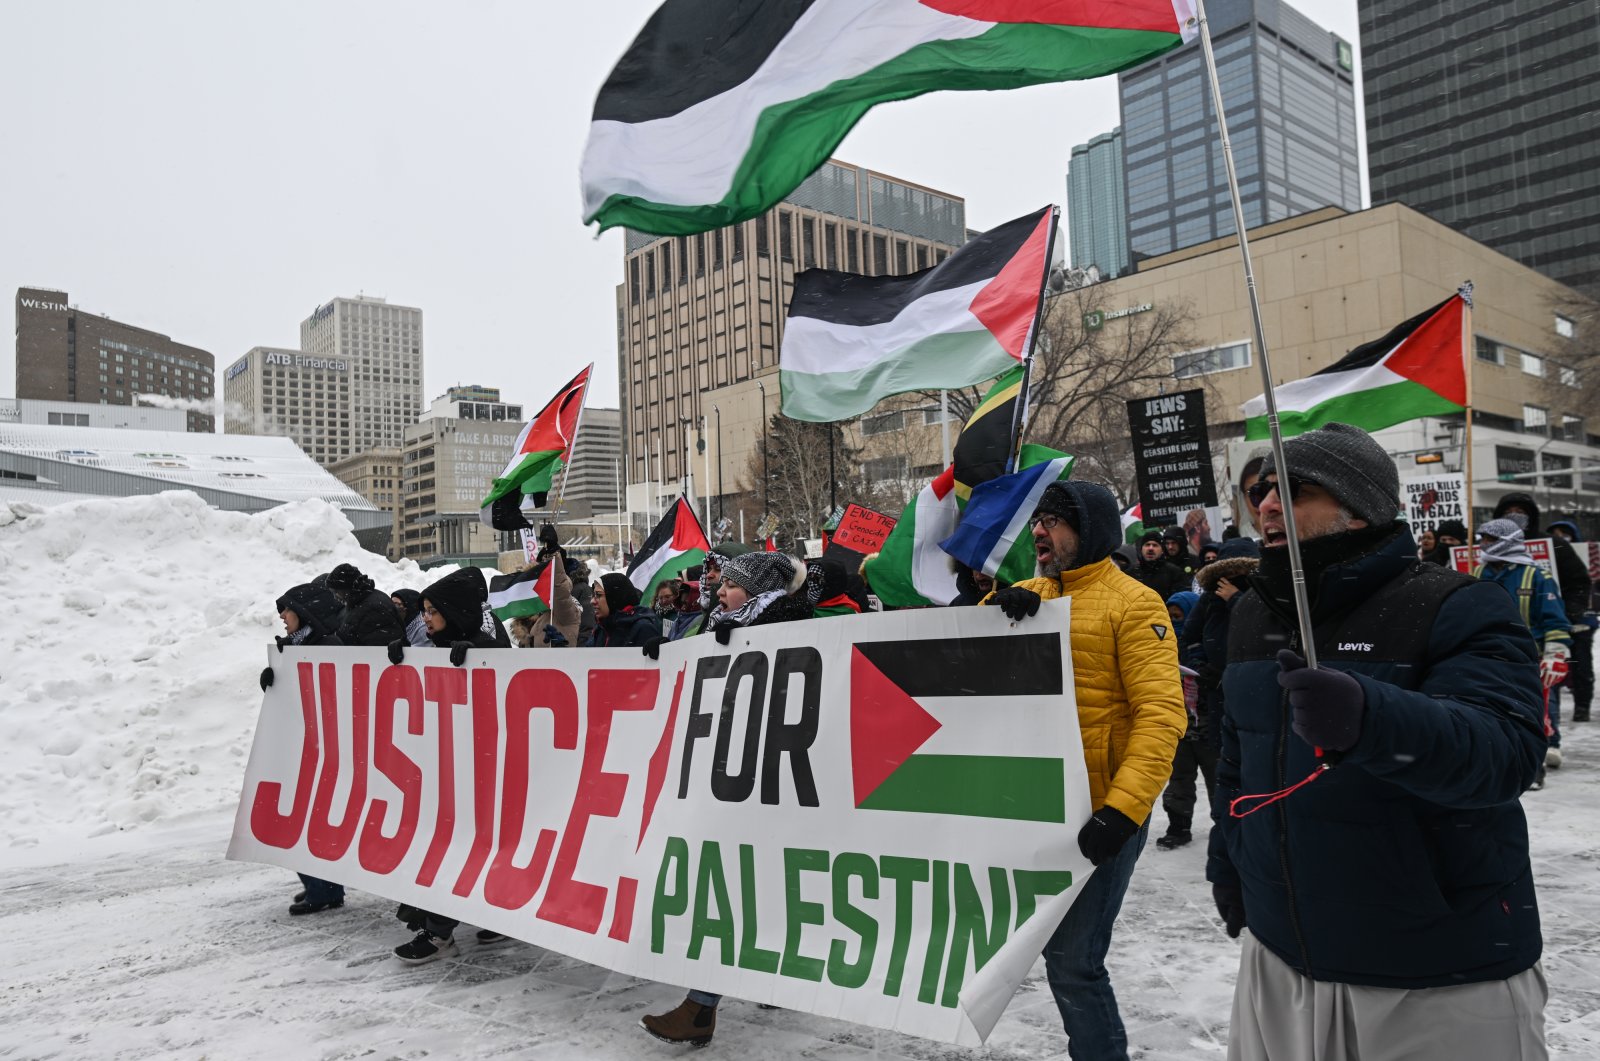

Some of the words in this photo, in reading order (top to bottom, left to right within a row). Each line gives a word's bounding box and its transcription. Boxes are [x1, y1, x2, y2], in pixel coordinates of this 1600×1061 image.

[21, 298, 68, 311] WESTIN
[266, 352, 291, 365] ATB
[295, 354, 348, 371] Financial
[1145, 395, 1187, 417] JEWS
[1151, 415, 1185, 435] SAY:
[454, 432, 480, 444] TAKE
[483, 433, 490, 444] A
[454, 449, 474, 461] IT'S
[479, 451, 498, 462] THE
[1143, 445, 1180, 458] CEASEFIRE
[1181, 442, 1199, 452] NOW
[454, 462, 504, 475] EDMONTO
[1148, 465, 1163, 475] LIFT
[1164, 463, 1178, 473] THE
[1178, 460, 1199, 471] SIEGE
[455, 475, 486, 488] THING
[1149, 482, 1164, 491] END
[1164, 477, 1202, 489] CANADA'S
[1407, 483, 1435, 493] ISRAEL
[1436, 480, 1461, 490] KILLS
[455, 488, 476, 500] YOU
[1153, 487, 1199, 501] COMPLICITY
[850, 507, 874, 520] END
[877, 515, 895, 529] THE
[1150, 507, 1168, 517] FREE
[1411, 506, 1426, 519] IN
[1428, 503, 1462, 519] GAZA
[849, 520, 885, 538] Genocide
[678, 645, 823, 807] FOR
